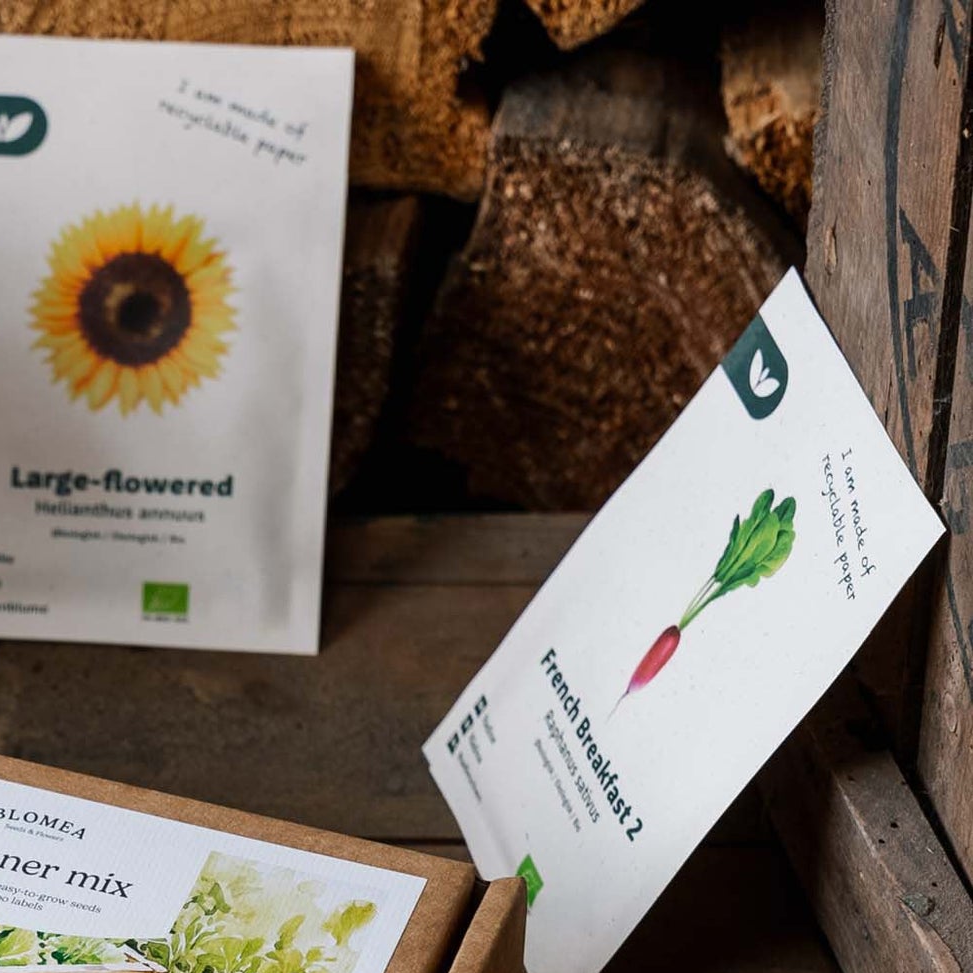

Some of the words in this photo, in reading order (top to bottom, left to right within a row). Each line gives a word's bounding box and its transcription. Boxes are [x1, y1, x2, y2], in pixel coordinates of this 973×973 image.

[842, 448, 852, 460] I
[10, 465, 234, 497] Large-flowered
[844, 466, 856, 494] am
[821, 454, 845, 547] recyclable
[834, 552, 855, 600] paper
[851, 500, 867, 551] made
[861, 556, 876, 577] of
[540, 648, 581, 723] French
[576, 716, 632, 825] Breakfast
[626, 817, 643, 842] 2
[574, 775, 600, 824] sativus
[65, 870, 133, 899] mix
[11, 897, 44, 911] labels
[70, 900, 102, 914] seeds
